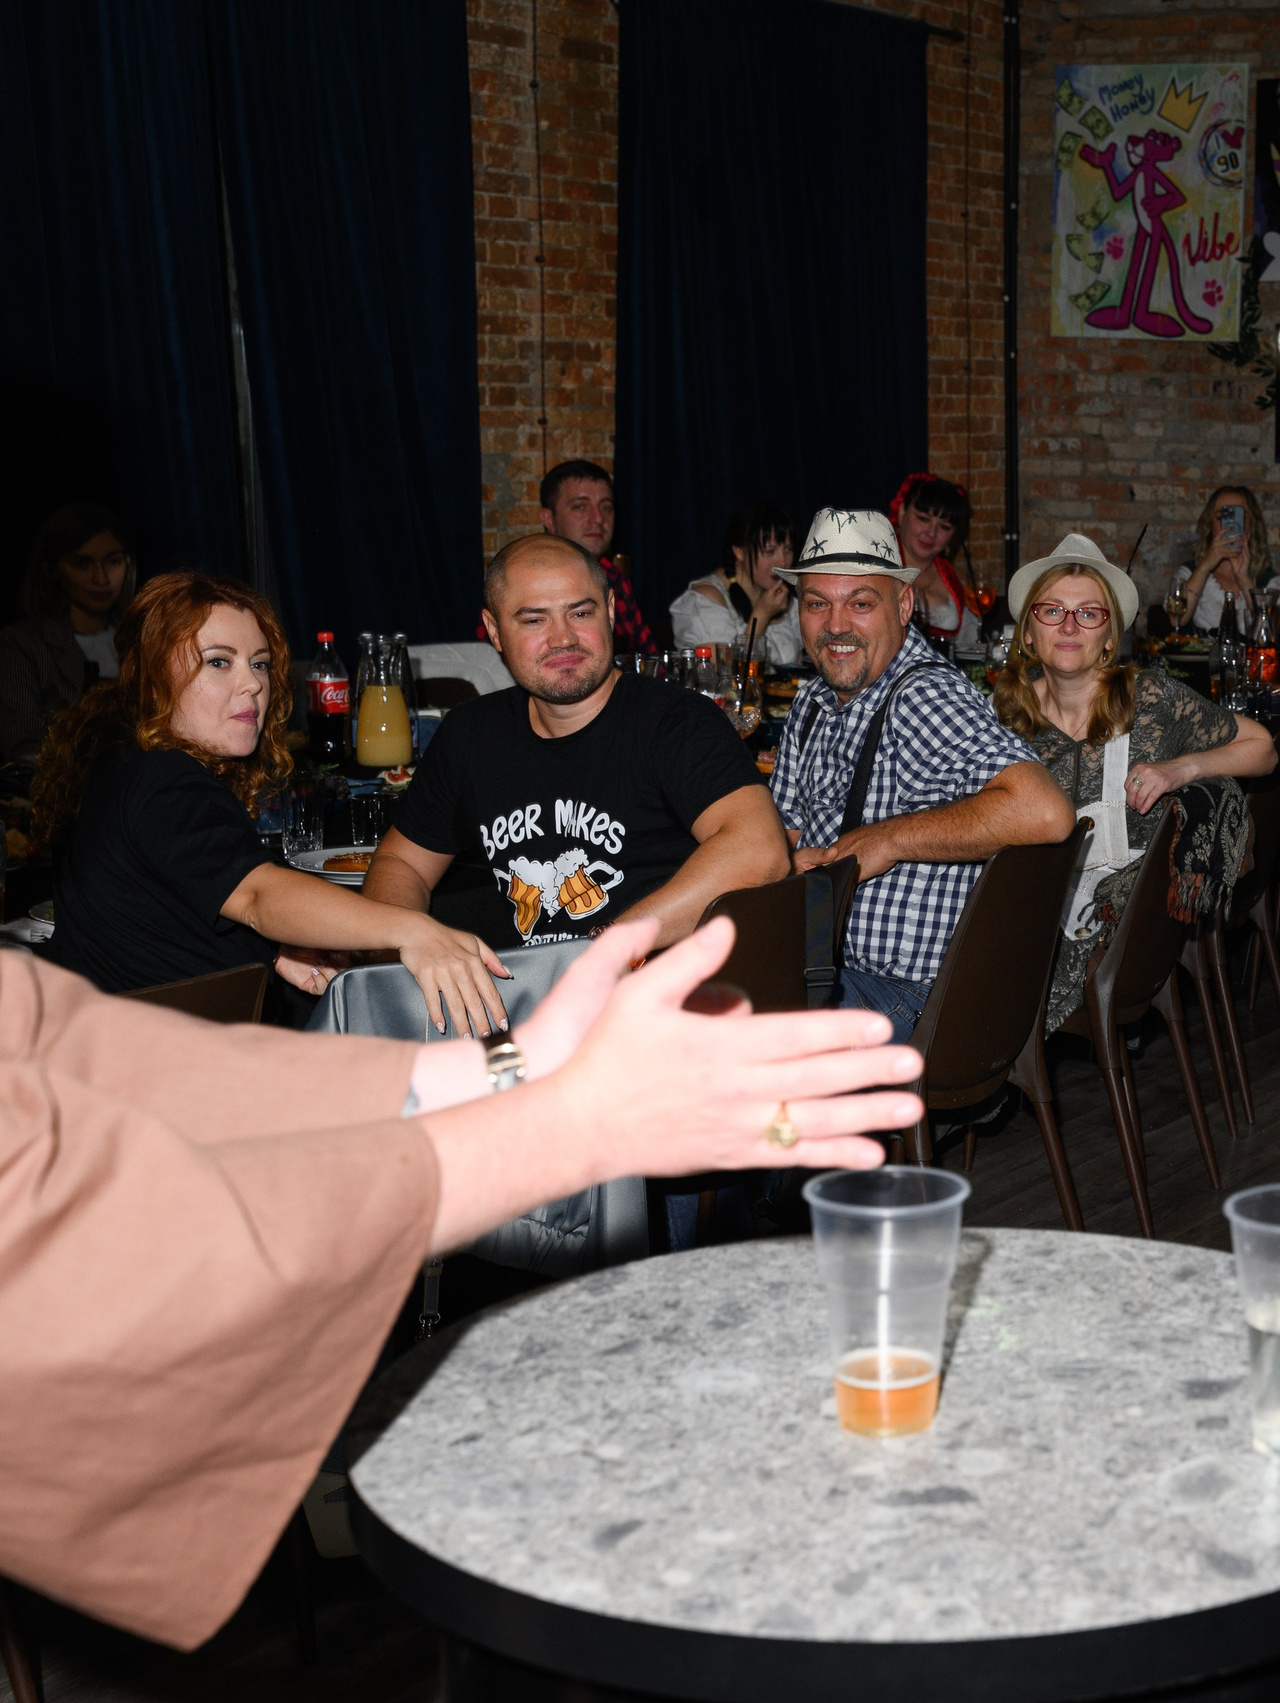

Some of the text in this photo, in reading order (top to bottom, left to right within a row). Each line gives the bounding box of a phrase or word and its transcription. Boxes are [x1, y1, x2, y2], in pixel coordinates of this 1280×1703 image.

[1098, 73, 1144, 106] Money
[1110, 87, 1155, 123] Honey
[1217, 151, 1240, 173] 90
[1183, 212, 1240, 267] Vibe
